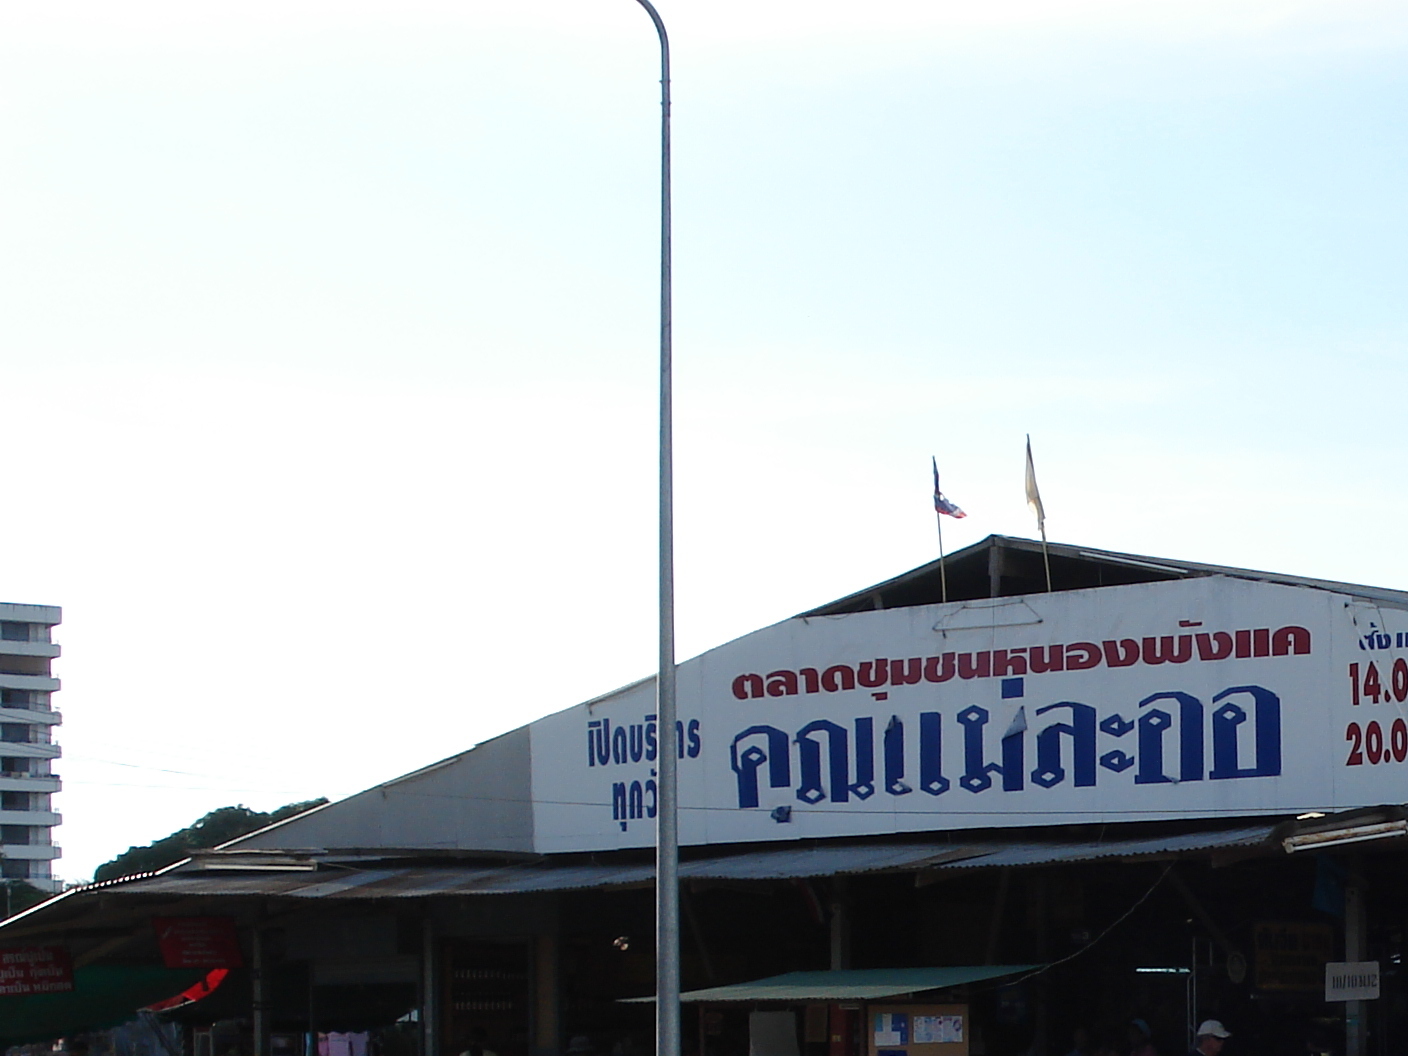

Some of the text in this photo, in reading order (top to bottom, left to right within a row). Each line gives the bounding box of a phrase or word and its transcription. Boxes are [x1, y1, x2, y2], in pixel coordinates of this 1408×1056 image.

[732, 620, 1312, 701] ตลาดชุมชนหนองพังแค
[587, 714, 701, 767] เปิดบริาร
[730, 677, 1282, 824] คุณแม่ละออ
[612, 768, 658, 832] ทุกวั
